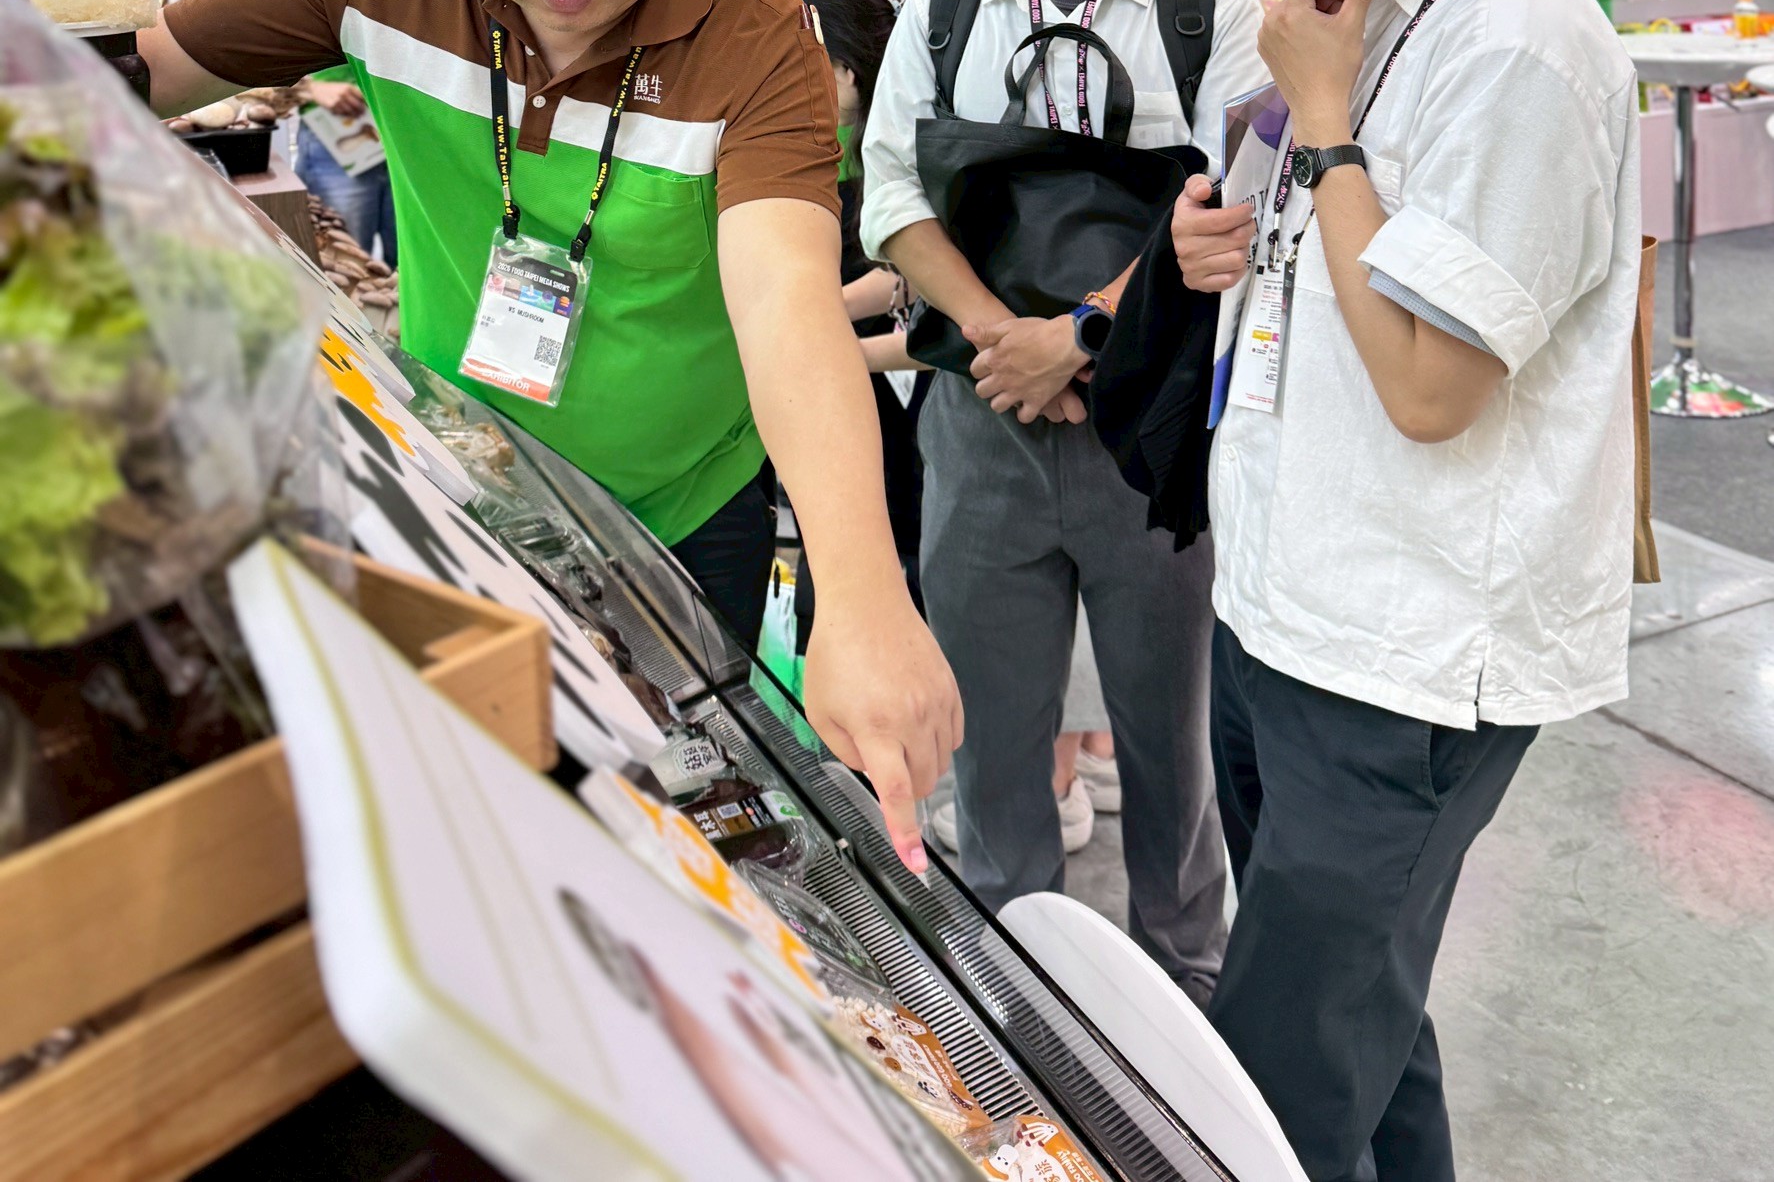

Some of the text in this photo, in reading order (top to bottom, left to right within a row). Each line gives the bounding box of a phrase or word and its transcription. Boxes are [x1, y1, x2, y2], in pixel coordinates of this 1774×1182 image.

[1032, 8, 1041, 24] FOOD
[493, 38, 503, 69] TAITRA
[634, 73, 664, 99] 萬生
[1078, 72, 1087, 107] FOOD TAIPEI
[593, 162, 607, 191] TAITRA
